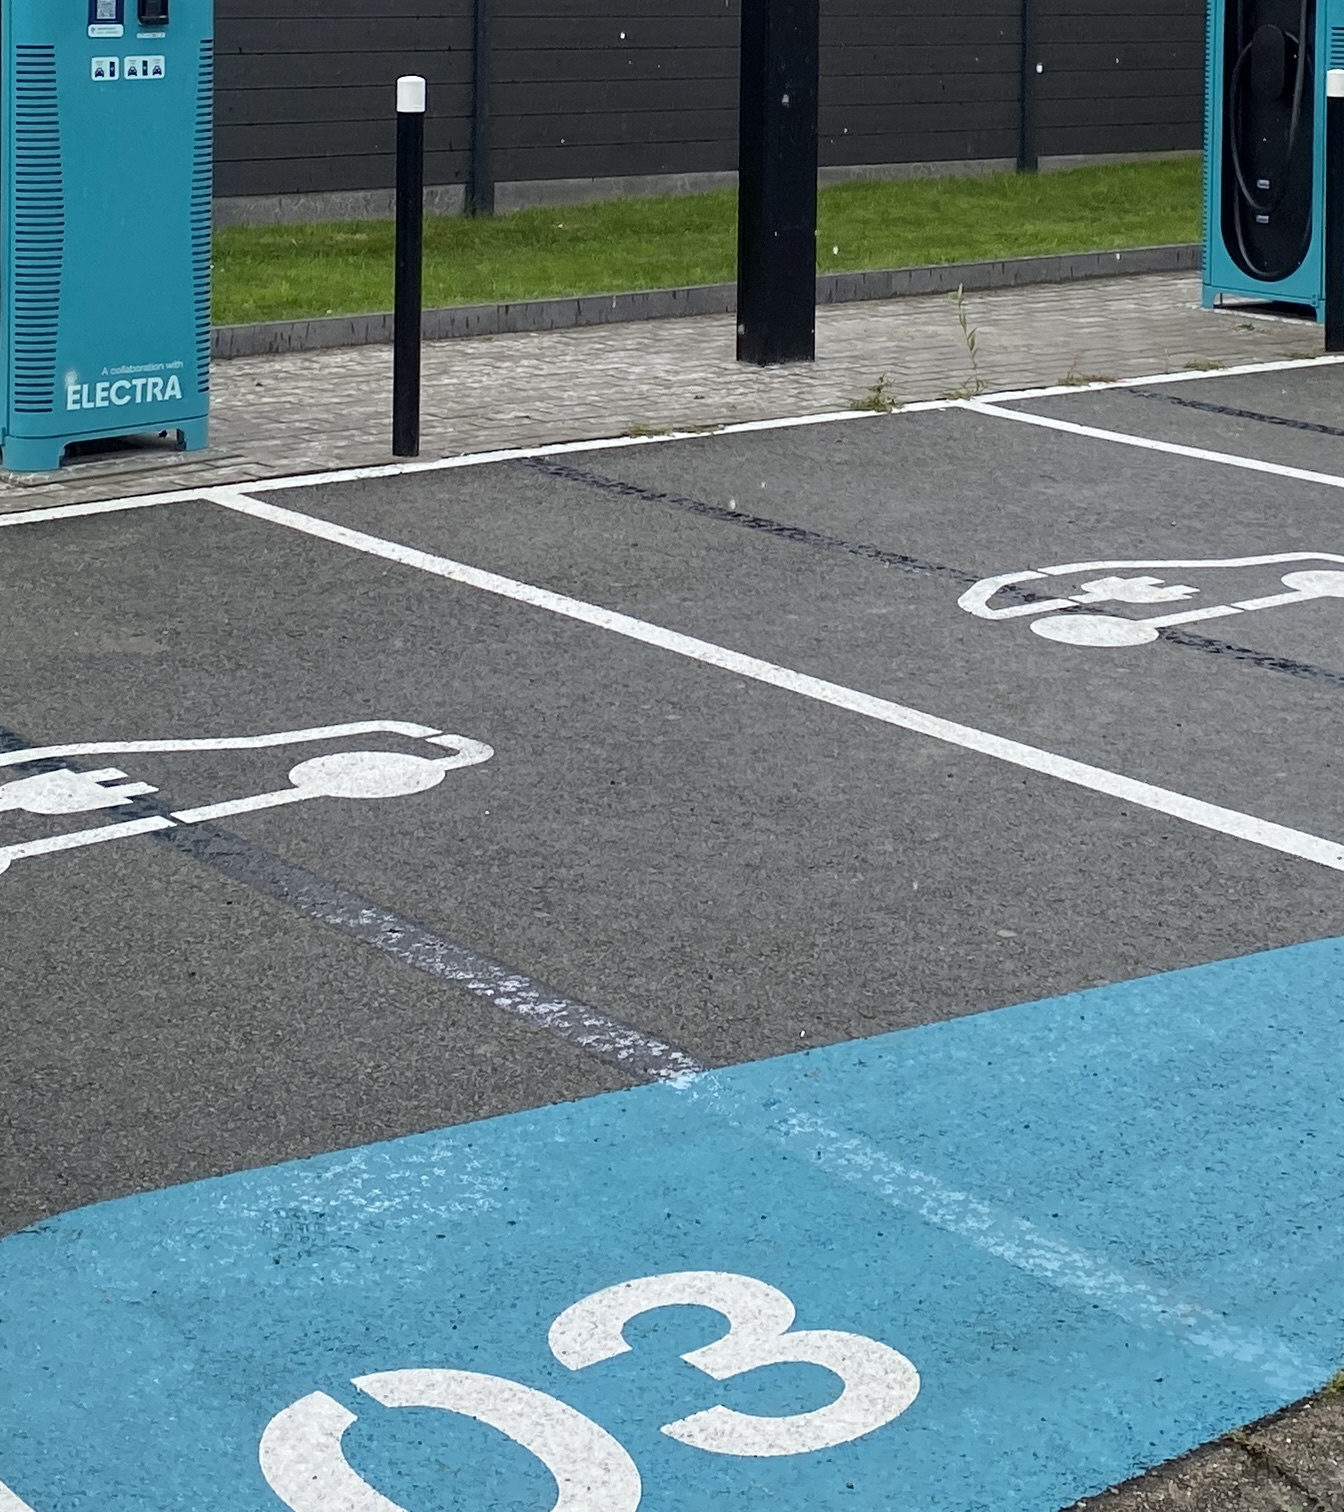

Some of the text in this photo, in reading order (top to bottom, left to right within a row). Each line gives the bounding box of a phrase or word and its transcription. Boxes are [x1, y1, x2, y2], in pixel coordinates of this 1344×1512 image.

[101, 359, 184, 376] A collaboration with
[66, 374, 183, 411] ELECTRA
[259, 1270, 921, 1512] 03
